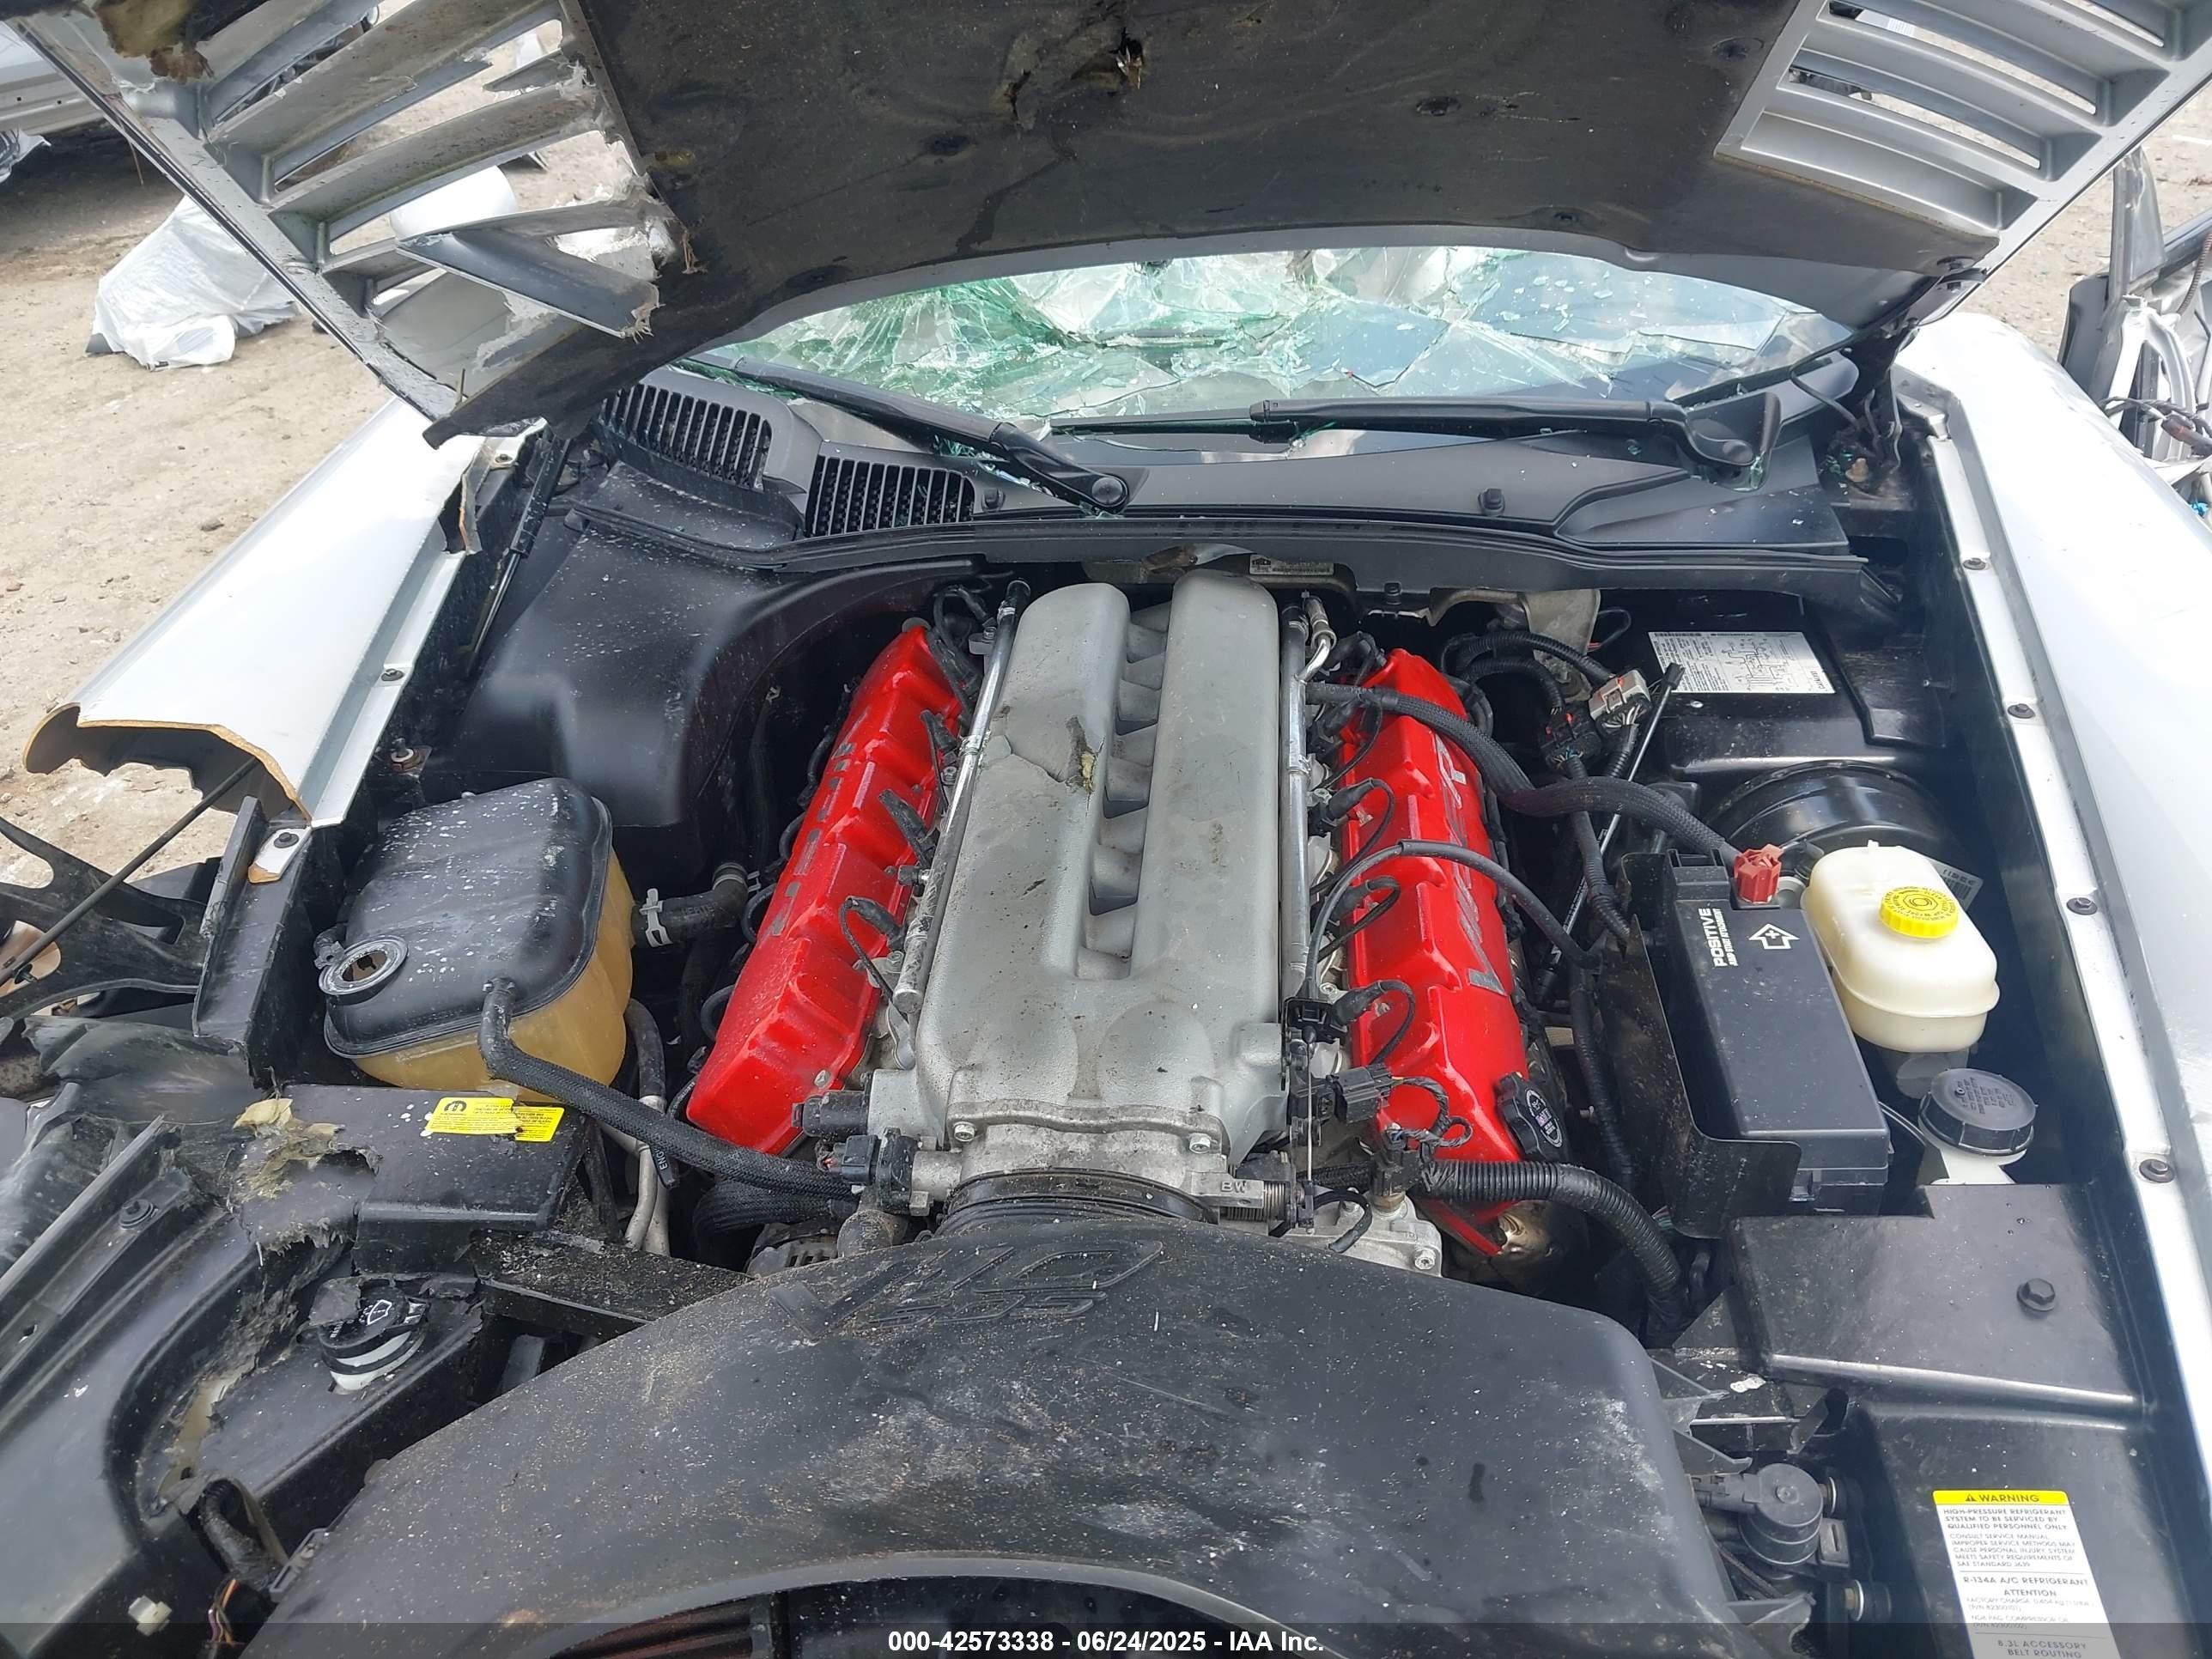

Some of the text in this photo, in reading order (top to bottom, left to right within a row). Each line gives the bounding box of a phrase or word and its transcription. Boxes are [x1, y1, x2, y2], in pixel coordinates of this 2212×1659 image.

[1698, 908, 1728, 967] POSITIVE
[1220, 1181, 1247, 1194] BW
[1978, 1493, 2040, 1503] WARNING
[2021, 1577, 2089, 1586] REFRIGERANT
[2022, 1640, 2087, 1650] ACCESSORY
[2033, 1649, 2082, 1658] ROUTING
